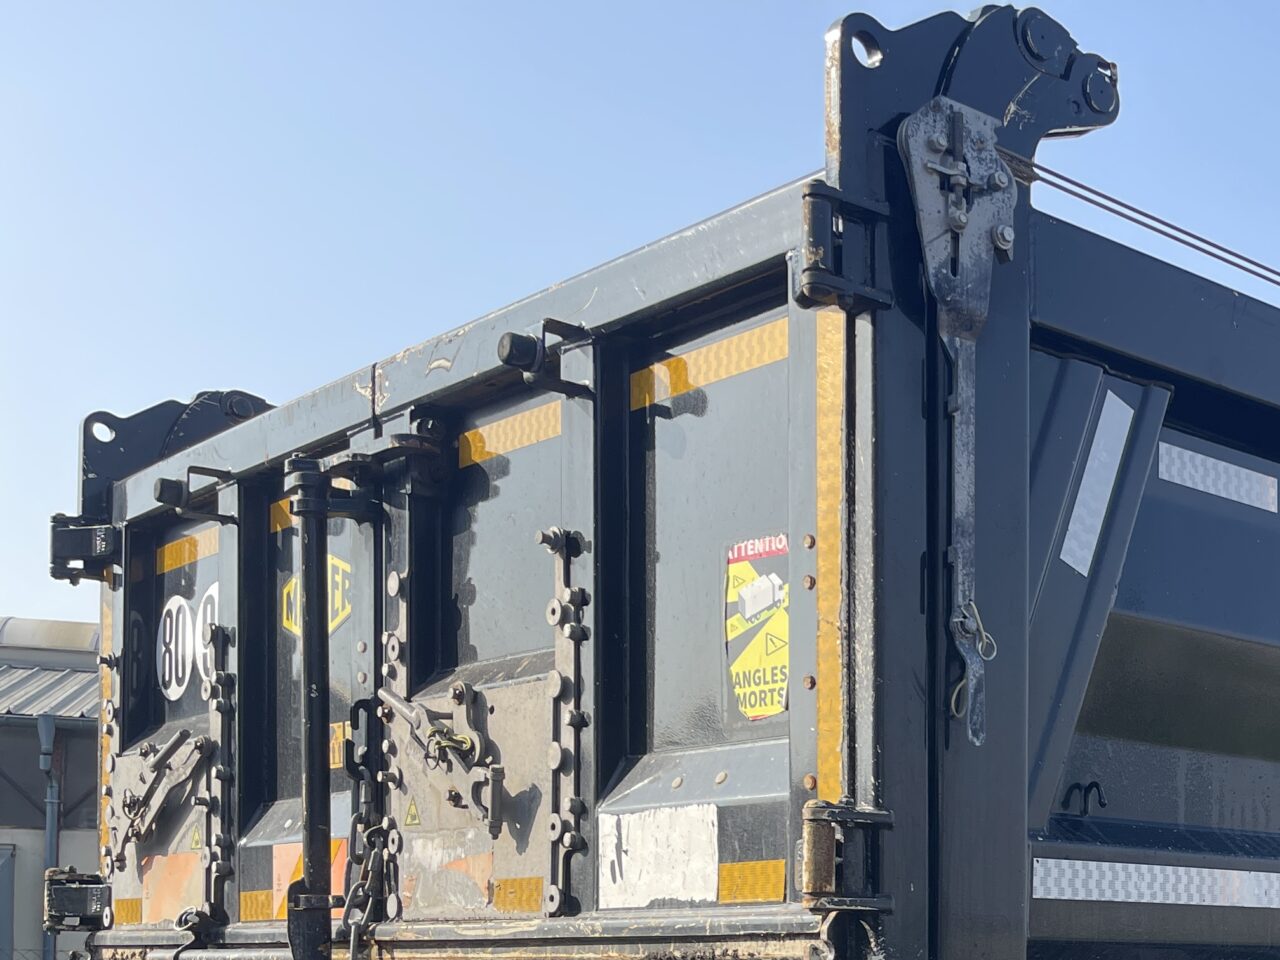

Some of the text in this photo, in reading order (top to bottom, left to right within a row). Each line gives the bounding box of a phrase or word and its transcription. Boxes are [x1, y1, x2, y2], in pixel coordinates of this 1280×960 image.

[162, 604, 187, 690] 80
[733, 664, 788, 690] ANGLES
[736, 686, 785, 709] MORTS
